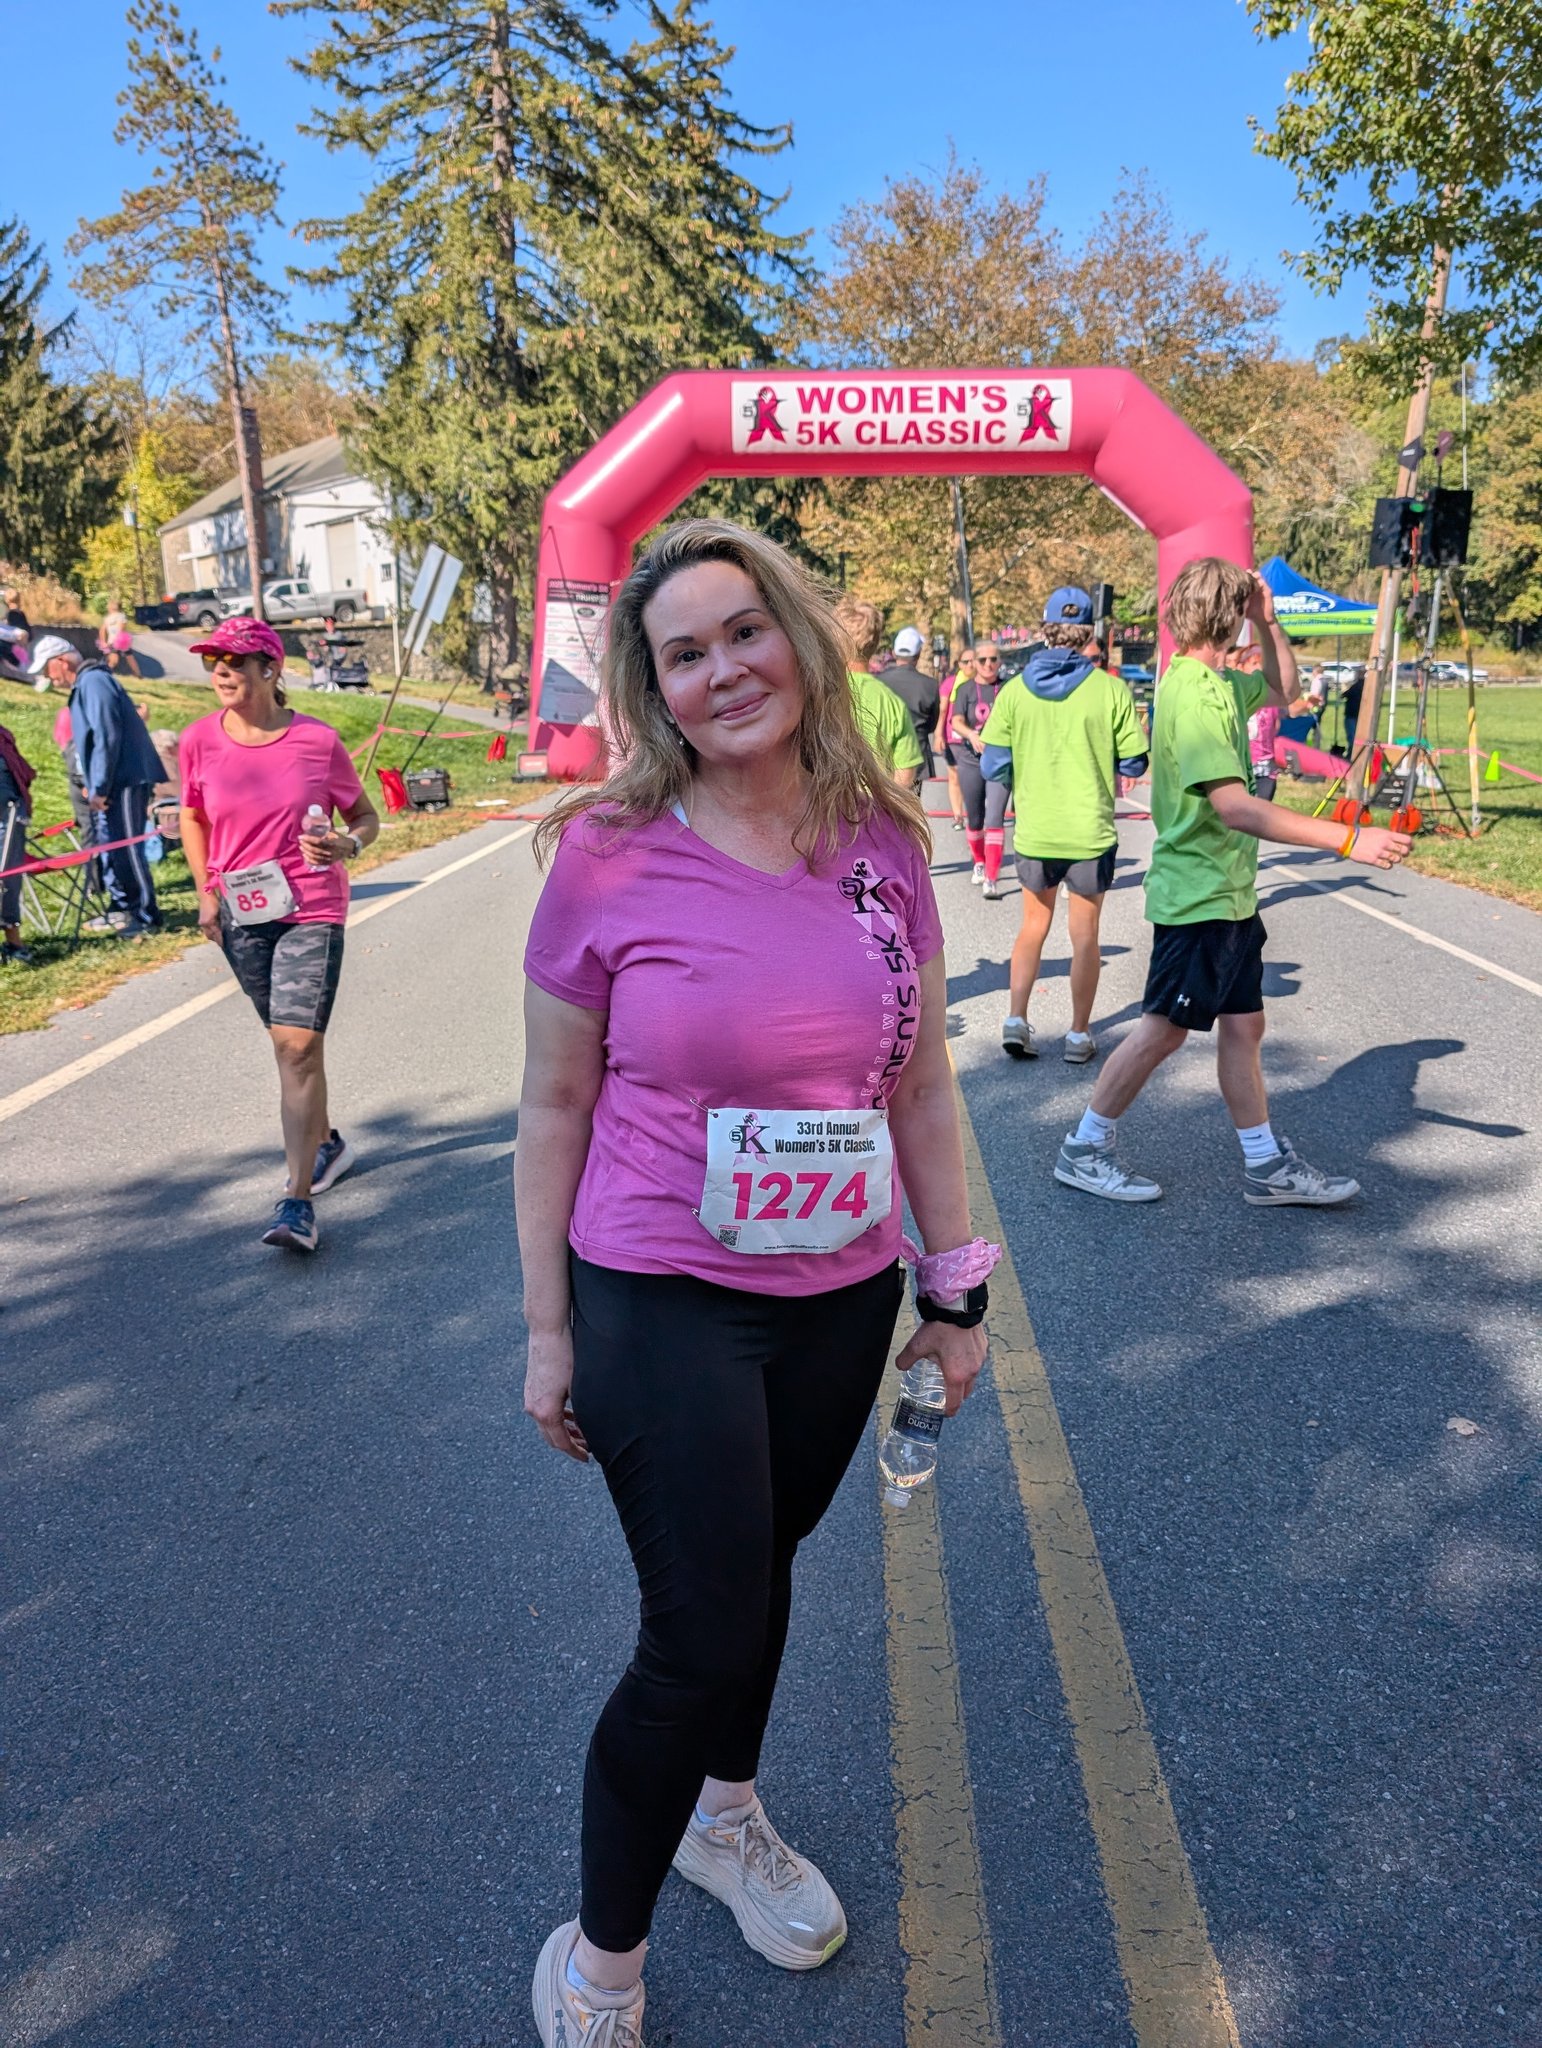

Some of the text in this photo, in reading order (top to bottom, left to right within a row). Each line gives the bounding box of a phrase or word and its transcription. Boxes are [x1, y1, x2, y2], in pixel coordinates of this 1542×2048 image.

[796, 385, 1007, 415] WOMEN'S
[796, 419, 1007, 446] 5K CLASSIC
[237, 889, 268, 912] 85
[858, 934, 880, 961] PA
[873, 932, 910, 974] 5K
[797, 1121, 860, 1135] 33rd Annual
[775, 1137, 875, 1153] Women's 5K Classic
[732, 1171, 868, 1220] 1274
[907, 1417, 940, 1432] nirvana
